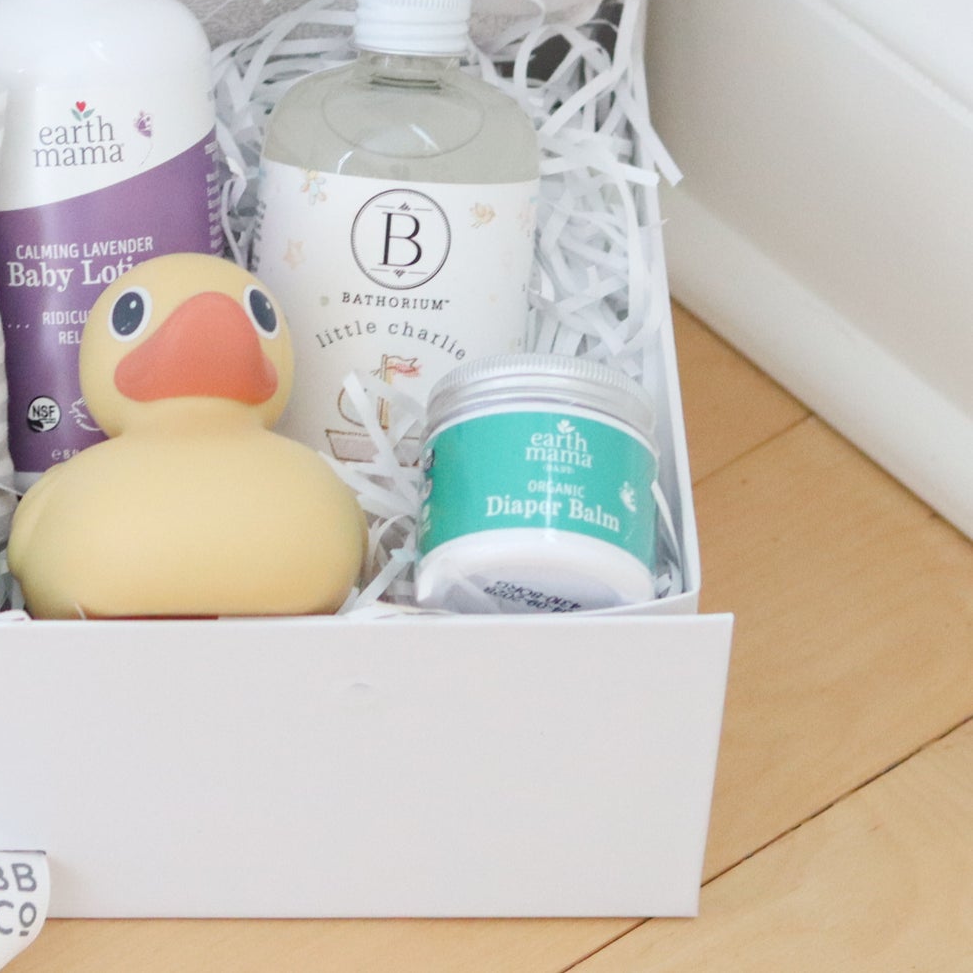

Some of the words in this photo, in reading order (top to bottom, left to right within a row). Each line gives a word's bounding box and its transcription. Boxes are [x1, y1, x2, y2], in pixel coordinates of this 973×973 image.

[38, 115, 116, 146] earth
[33, 142, 124, 168] mama
[15, 243, 79, 261] CALMING
[83, 235, 154, 258] LAVENDER
[379, 211, 423, 267] B
[7, 260, 75, 292] Baby
[81, 255, 134, 286] Loti
[42, 310, 87, 326] RIDICU
[315, 319, 378, 349] little
[387, 320, 467, 362] charlie
[31, 404, 56, 418] NSF
[530, 431, 588, 453] earth
[524, 446, 594, 469] mama
[527, 479, 586, 499] ORGANIC
[485, 494, 563, 520] Diaper
[568, 498, 621, 533] Balm
